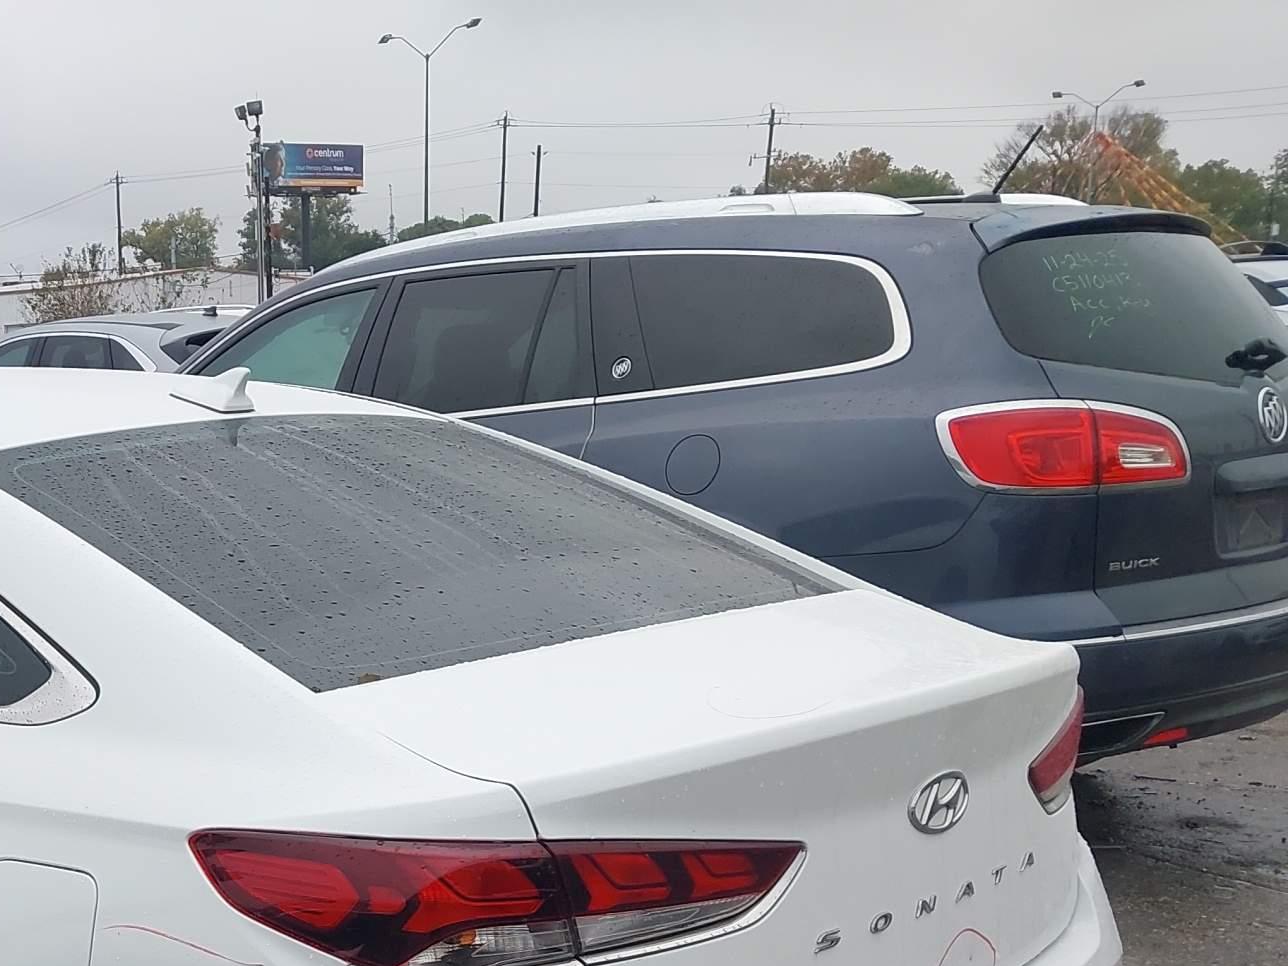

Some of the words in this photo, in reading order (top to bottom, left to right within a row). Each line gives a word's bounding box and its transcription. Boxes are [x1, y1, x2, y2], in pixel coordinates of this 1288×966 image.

[314, 148, 344, 158] centrum
[1109, 557, 1161, 571] BUICK
[814, 851, 1035, 955] SONATA
